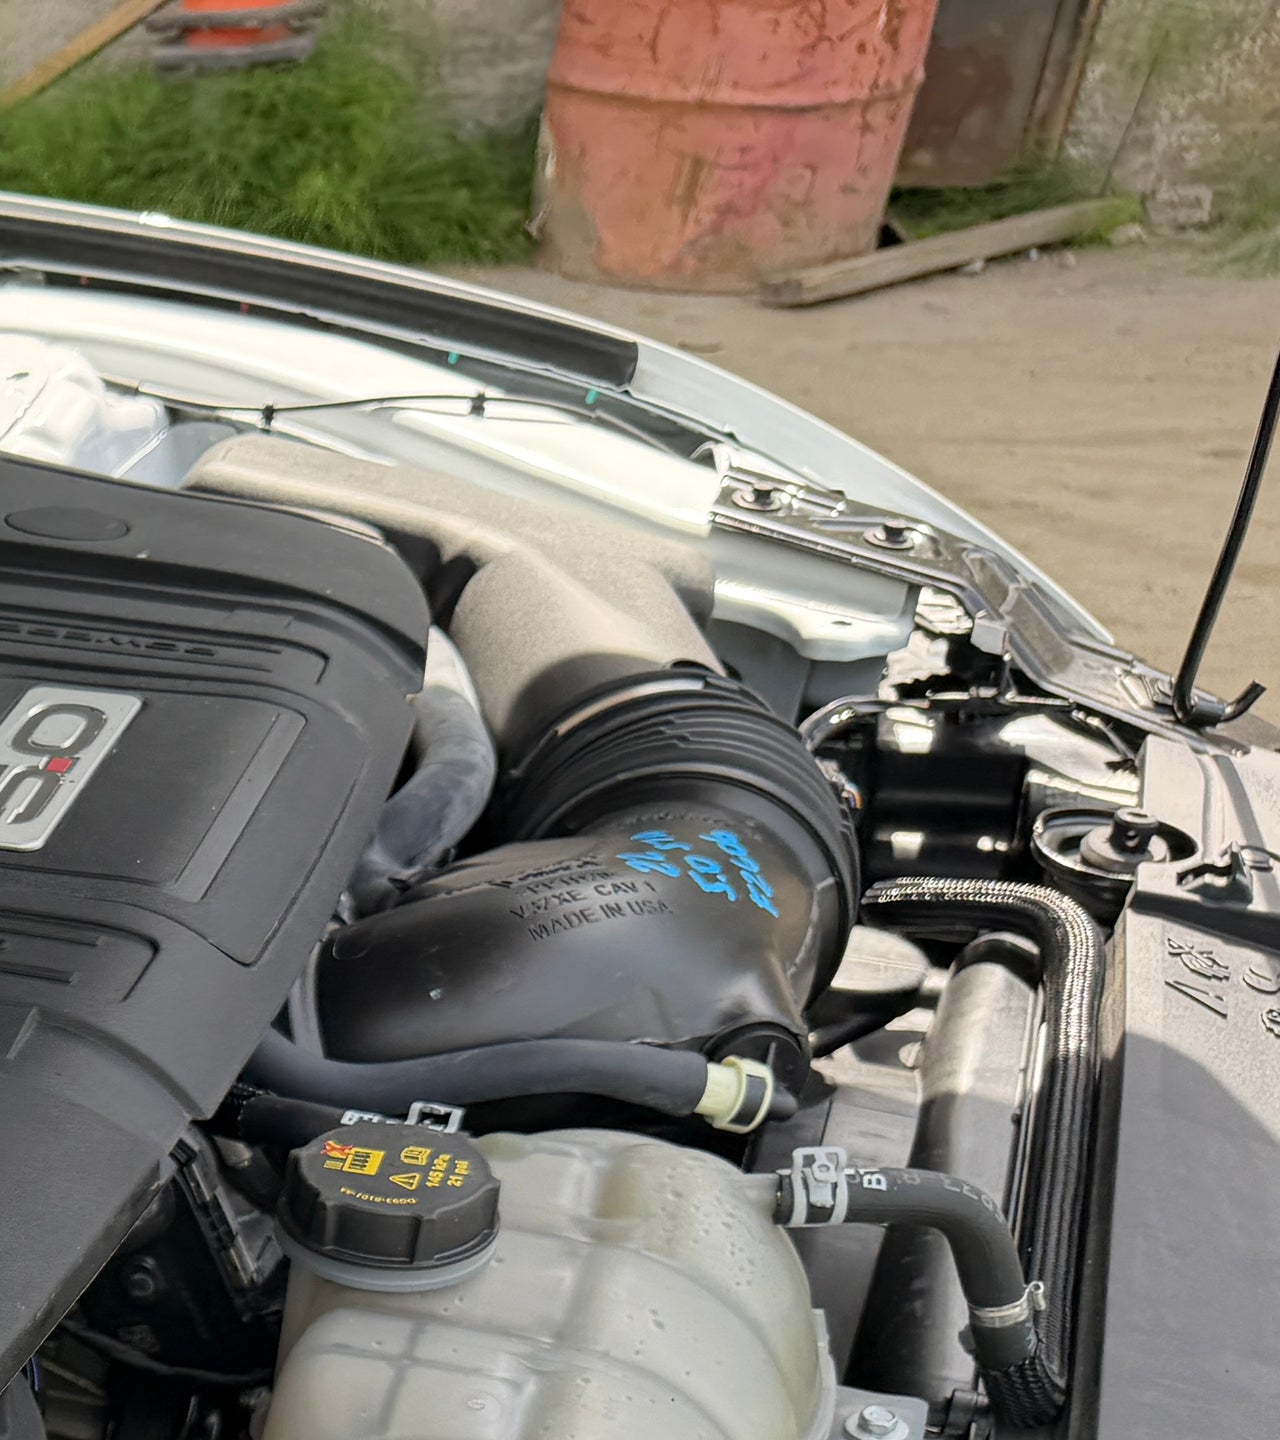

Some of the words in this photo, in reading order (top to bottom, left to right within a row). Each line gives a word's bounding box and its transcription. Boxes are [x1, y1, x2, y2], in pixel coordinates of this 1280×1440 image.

[592, 879, 640, 898] CAV
[528, 902, 600, 942] MADE
[604, 900, 628, 919] IN
[630, 898, 674, 918] USA
